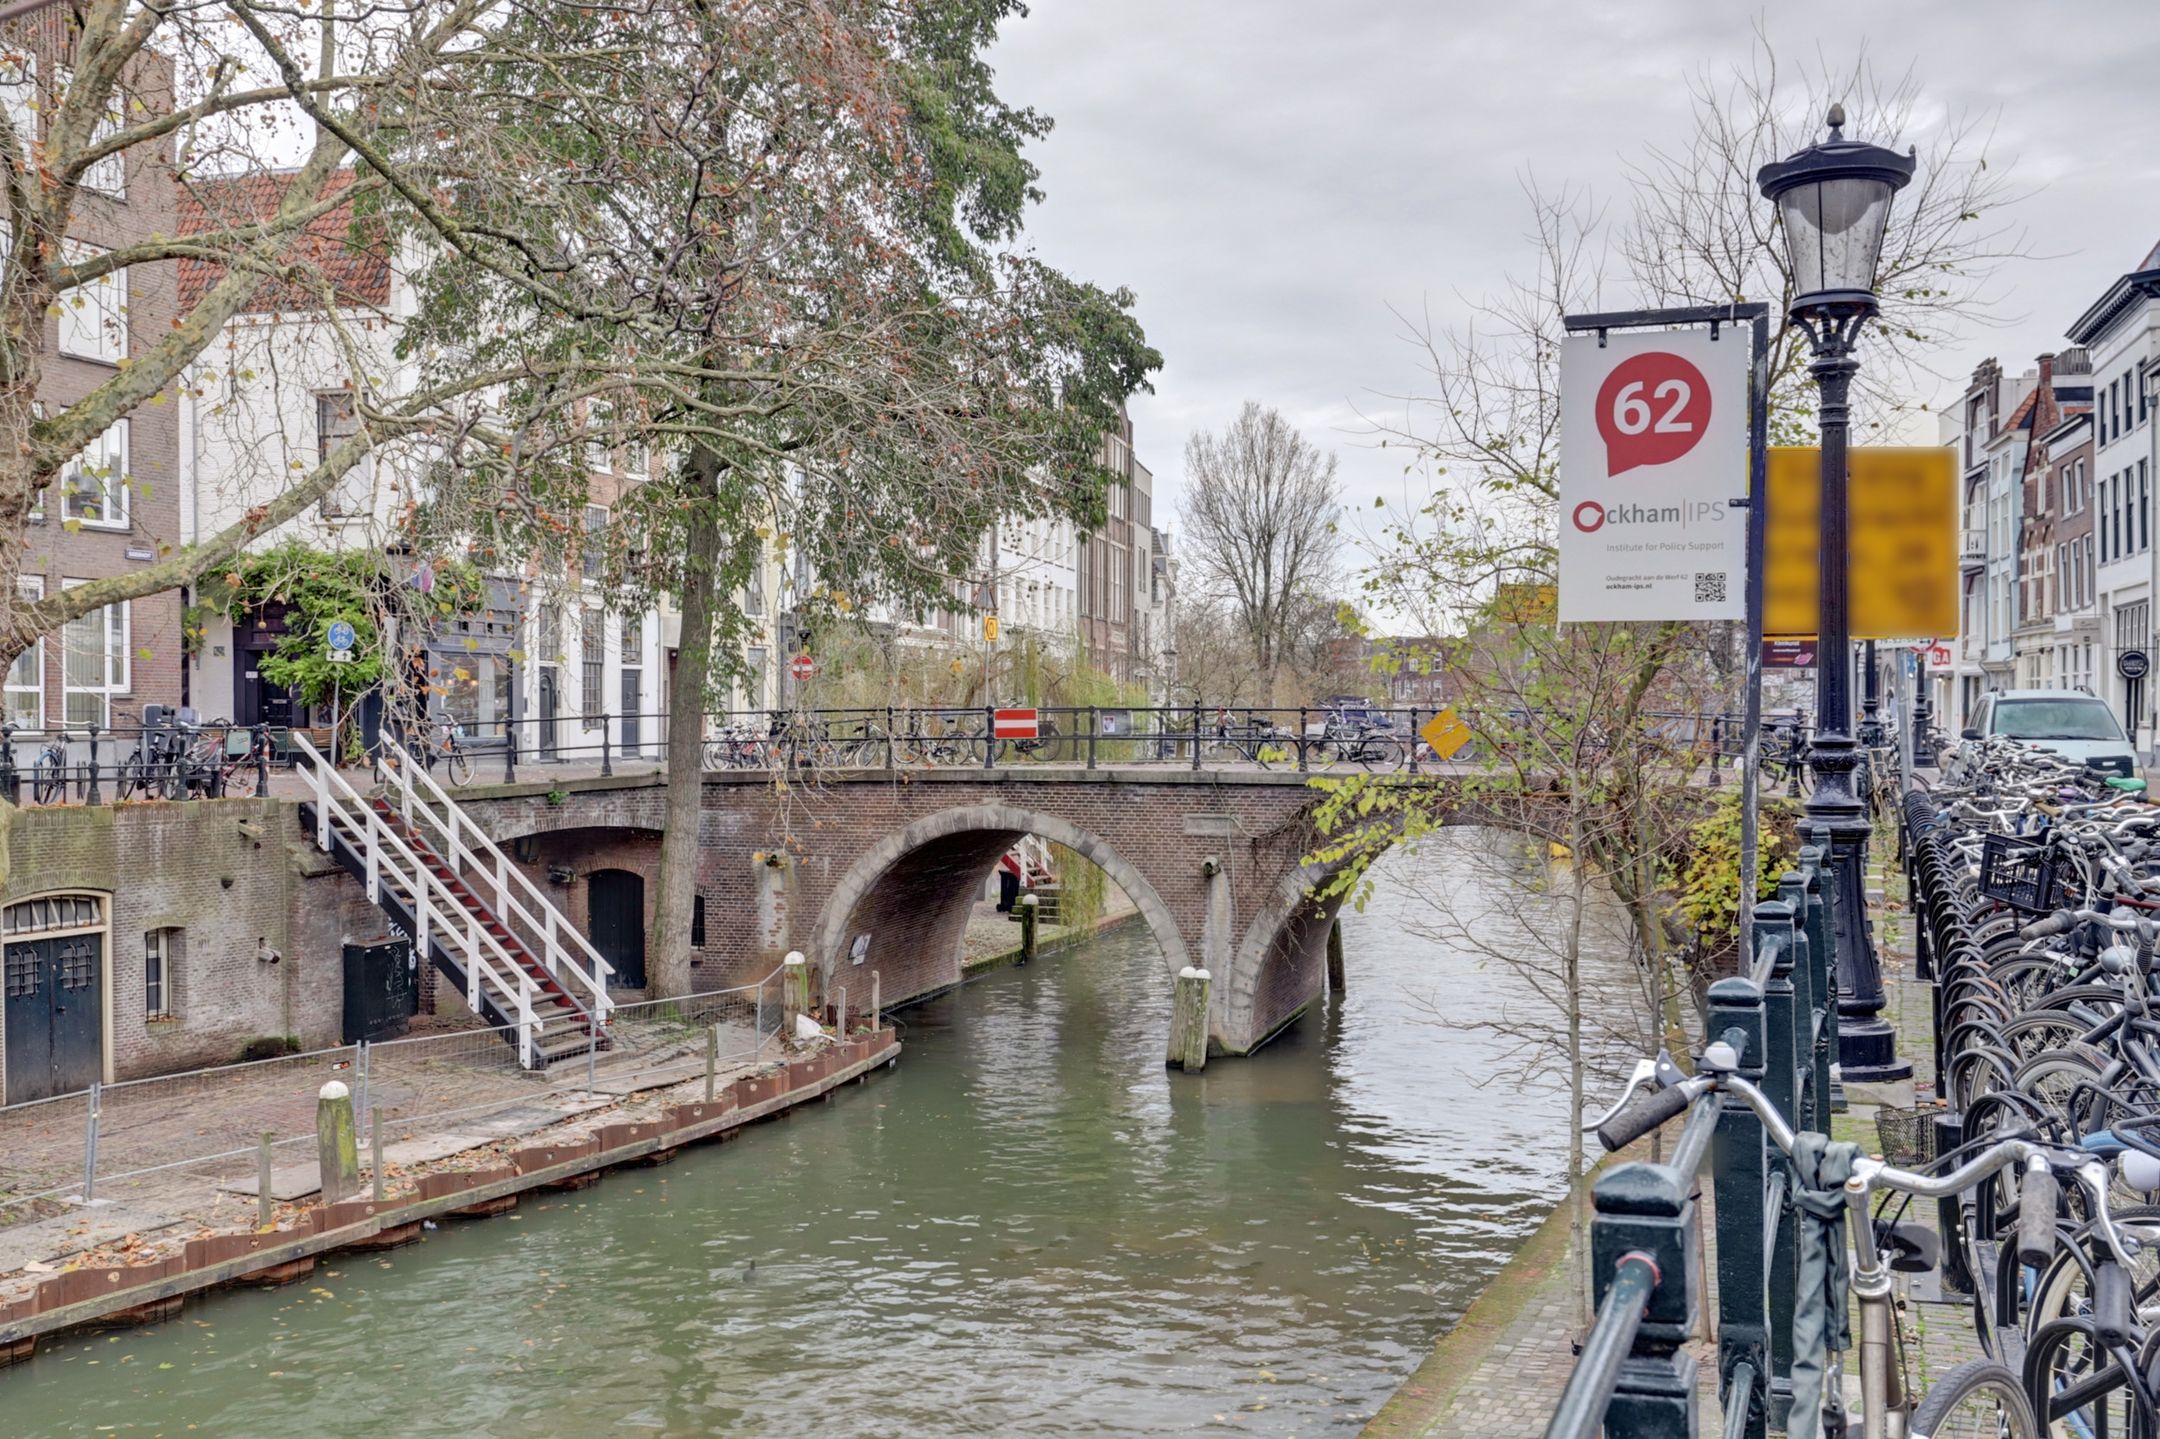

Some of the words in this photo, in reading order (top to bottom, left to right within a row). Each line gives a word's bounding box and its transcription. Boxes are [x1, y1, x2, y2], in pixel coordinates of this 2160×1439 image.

[1613, 378, 1692, 435] 62
[1688, 501, 1725, 521] IPS
[1606, 543, 1643, 552] Institute
[1645, 543, 1658, 551] for
[1659, 542, 1686, 552] Policy
[1688, 540, 1724, 552] Support
